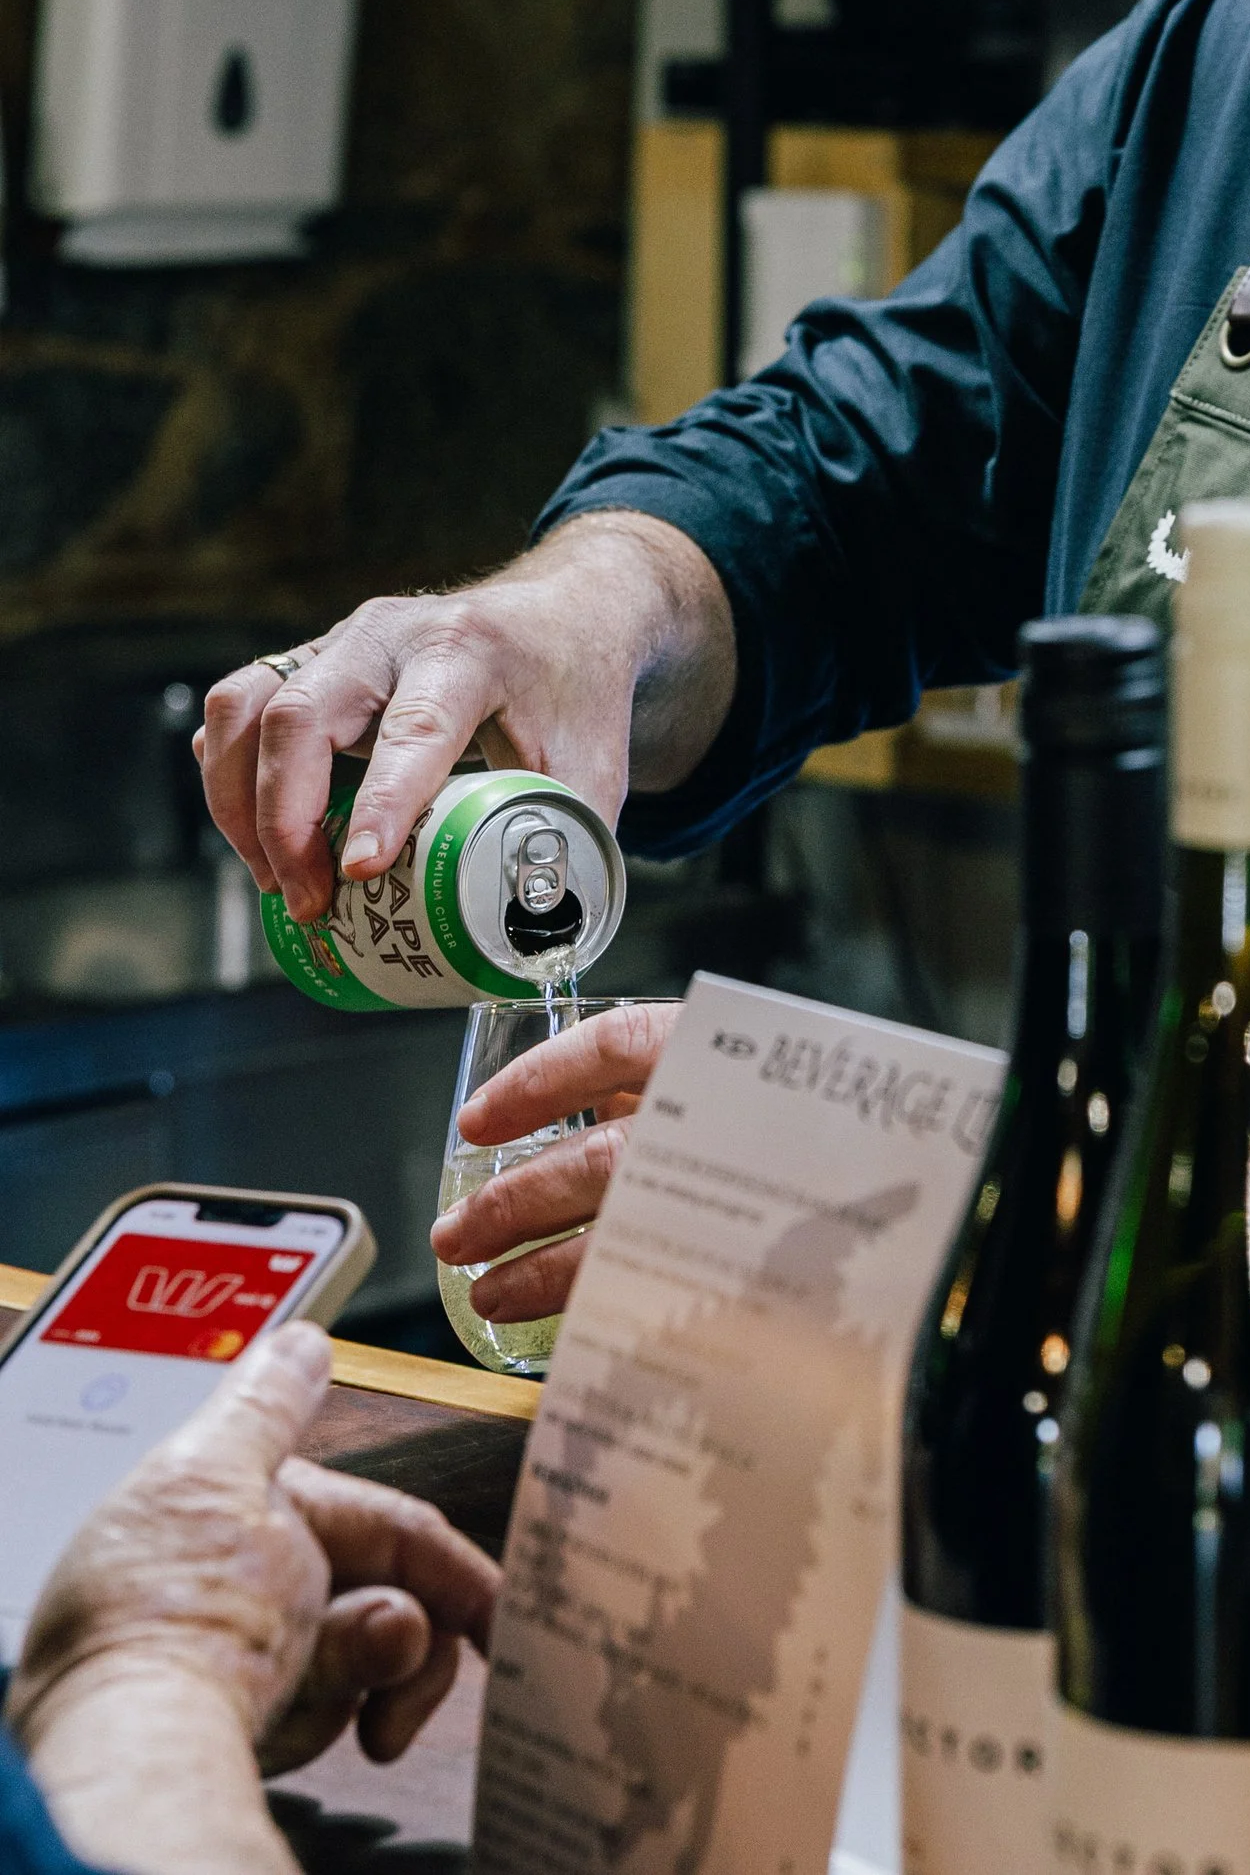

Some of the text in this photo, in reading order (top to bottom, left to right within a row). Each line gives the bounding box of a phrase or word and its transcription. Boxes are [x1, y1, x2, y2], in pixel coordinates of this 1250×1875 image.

[363, 872, 412, 973] OAT
[433, 833, 457, 949] PREMIUM CIDER
[292, 942, 339, 998] CIDER
[757, 1031, 952, 1139] BEVERAGE
